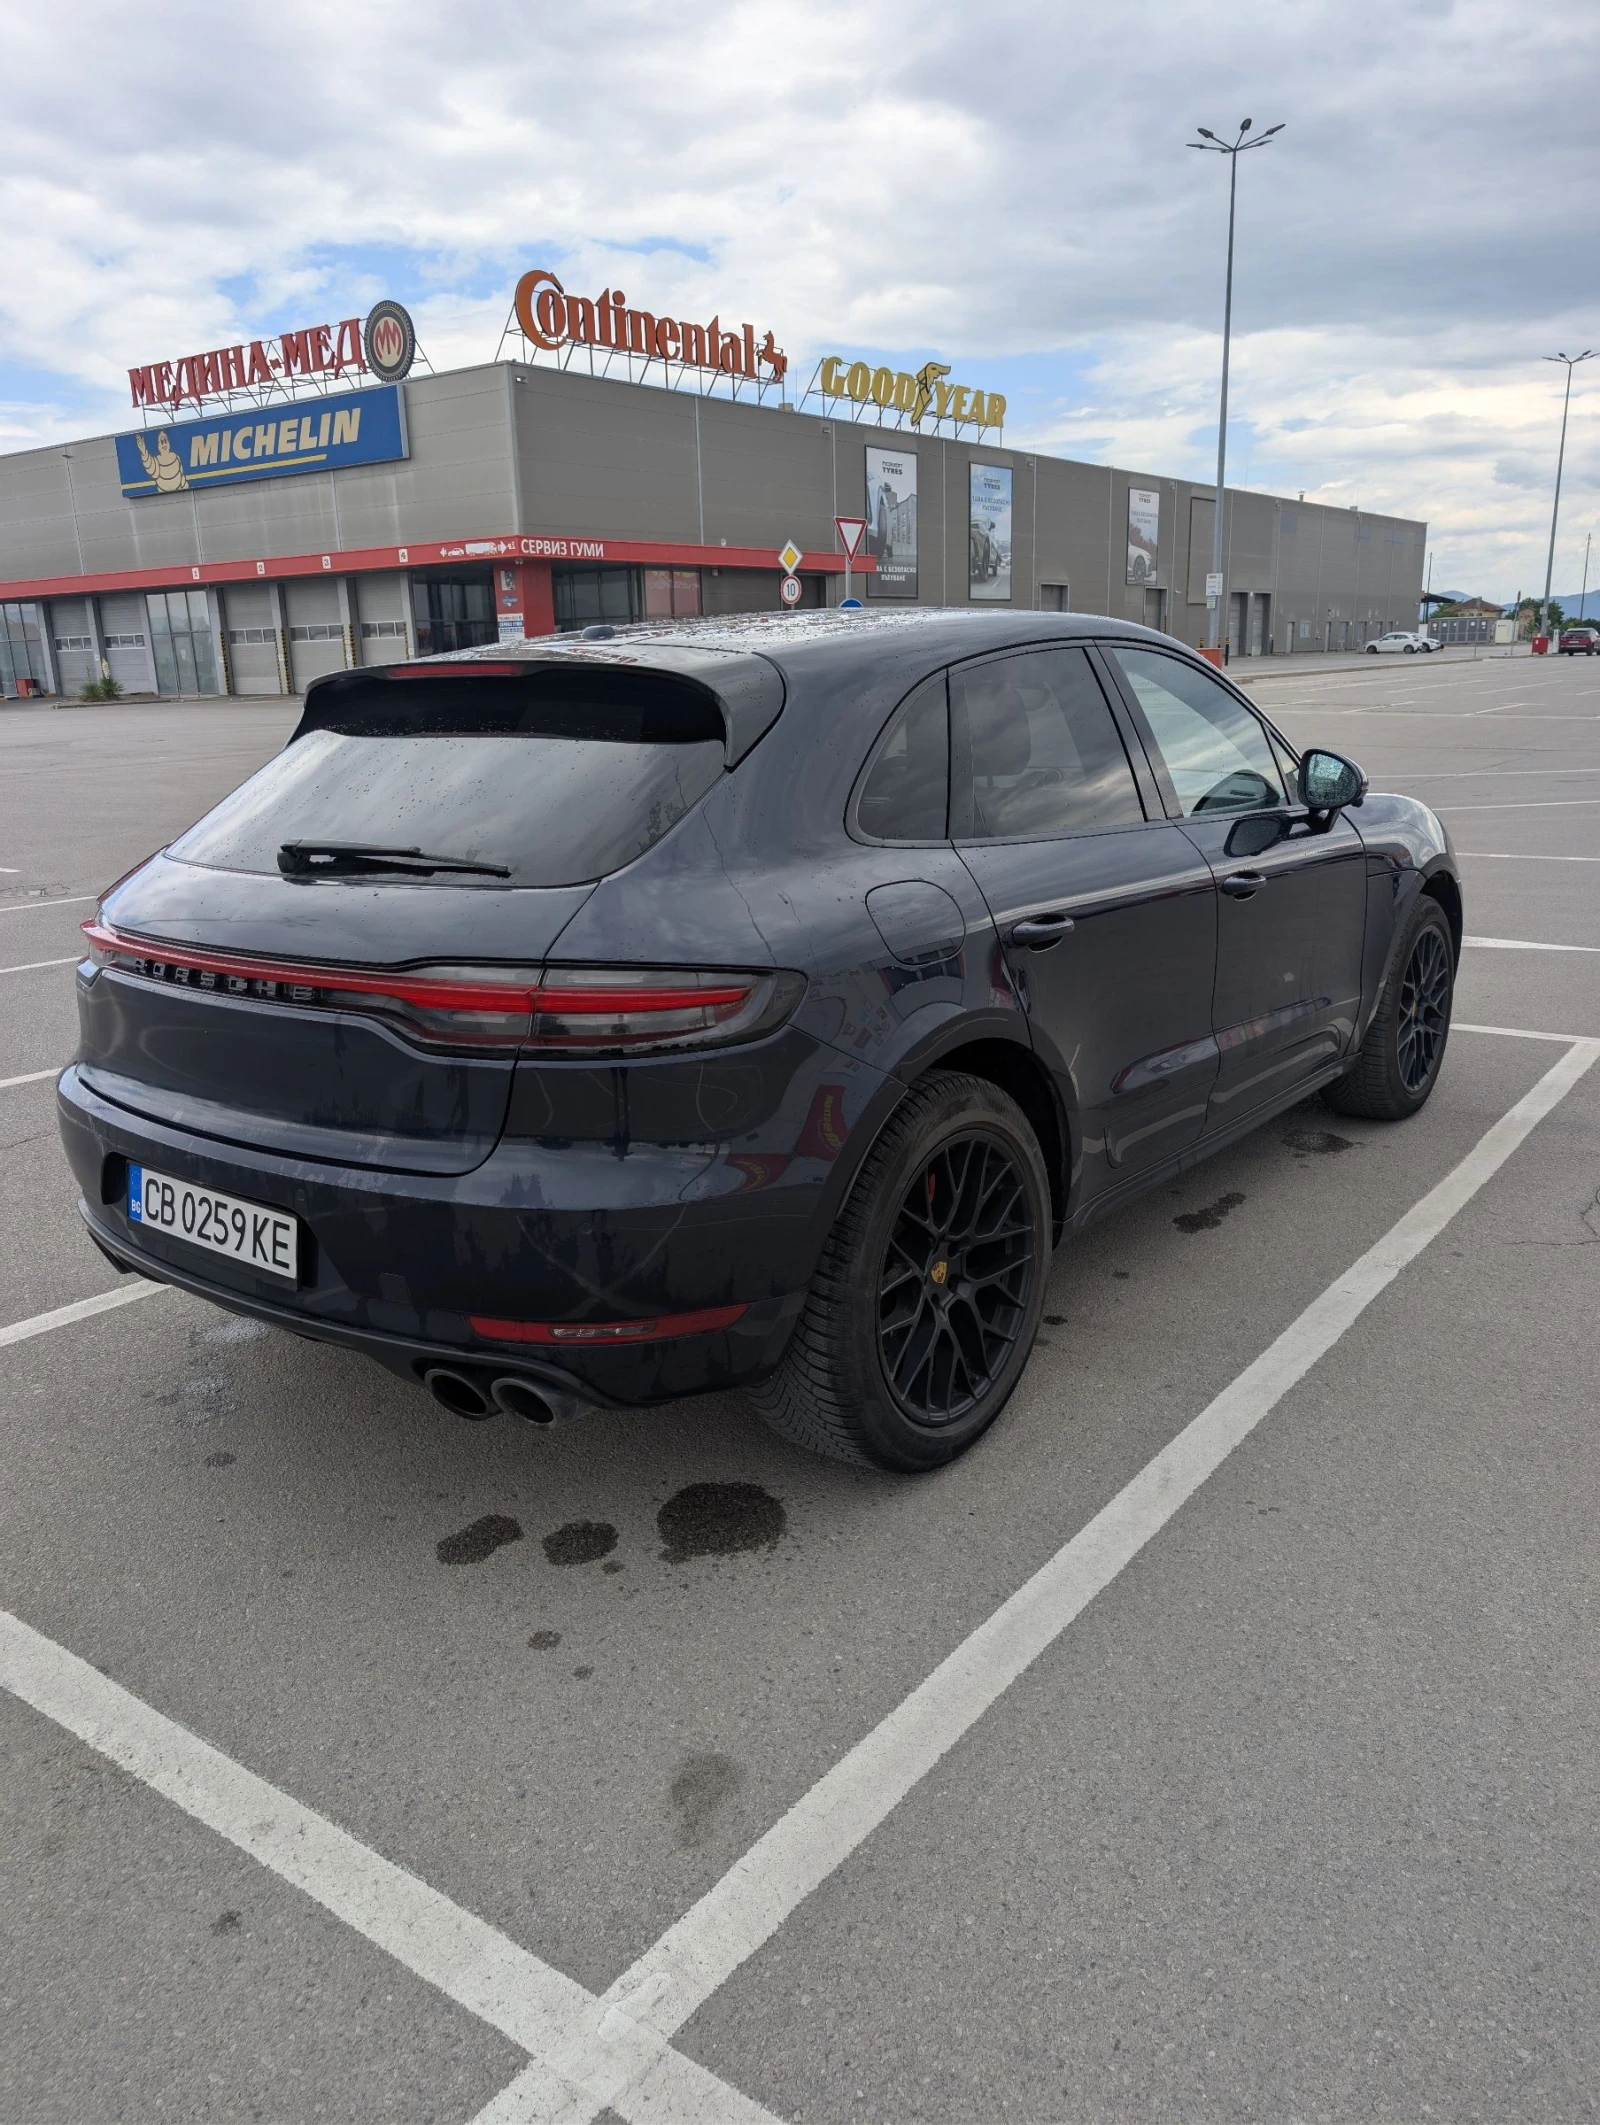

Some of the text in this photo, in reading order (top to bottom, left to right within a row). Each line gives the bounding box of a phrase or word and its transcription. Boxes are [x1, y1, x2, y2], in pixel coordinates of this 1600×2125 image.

[515, 270, 758, 379] Continental
[127, 317, 368, 411] МЕДИНА-МЕД
[189, 407, 362, 467] MICHELIN
[882, 467, 903, 475] TYRES
[521, 538, 604, 557] СЕРВИЗ ГУМИ
[787, 583, 796, 596] 10
[134, 957, 314, 1001] PORSCHE
[131, 1199, 141, 1213] BG
[145, 1178, 291, 1269] CB 0259 KE
